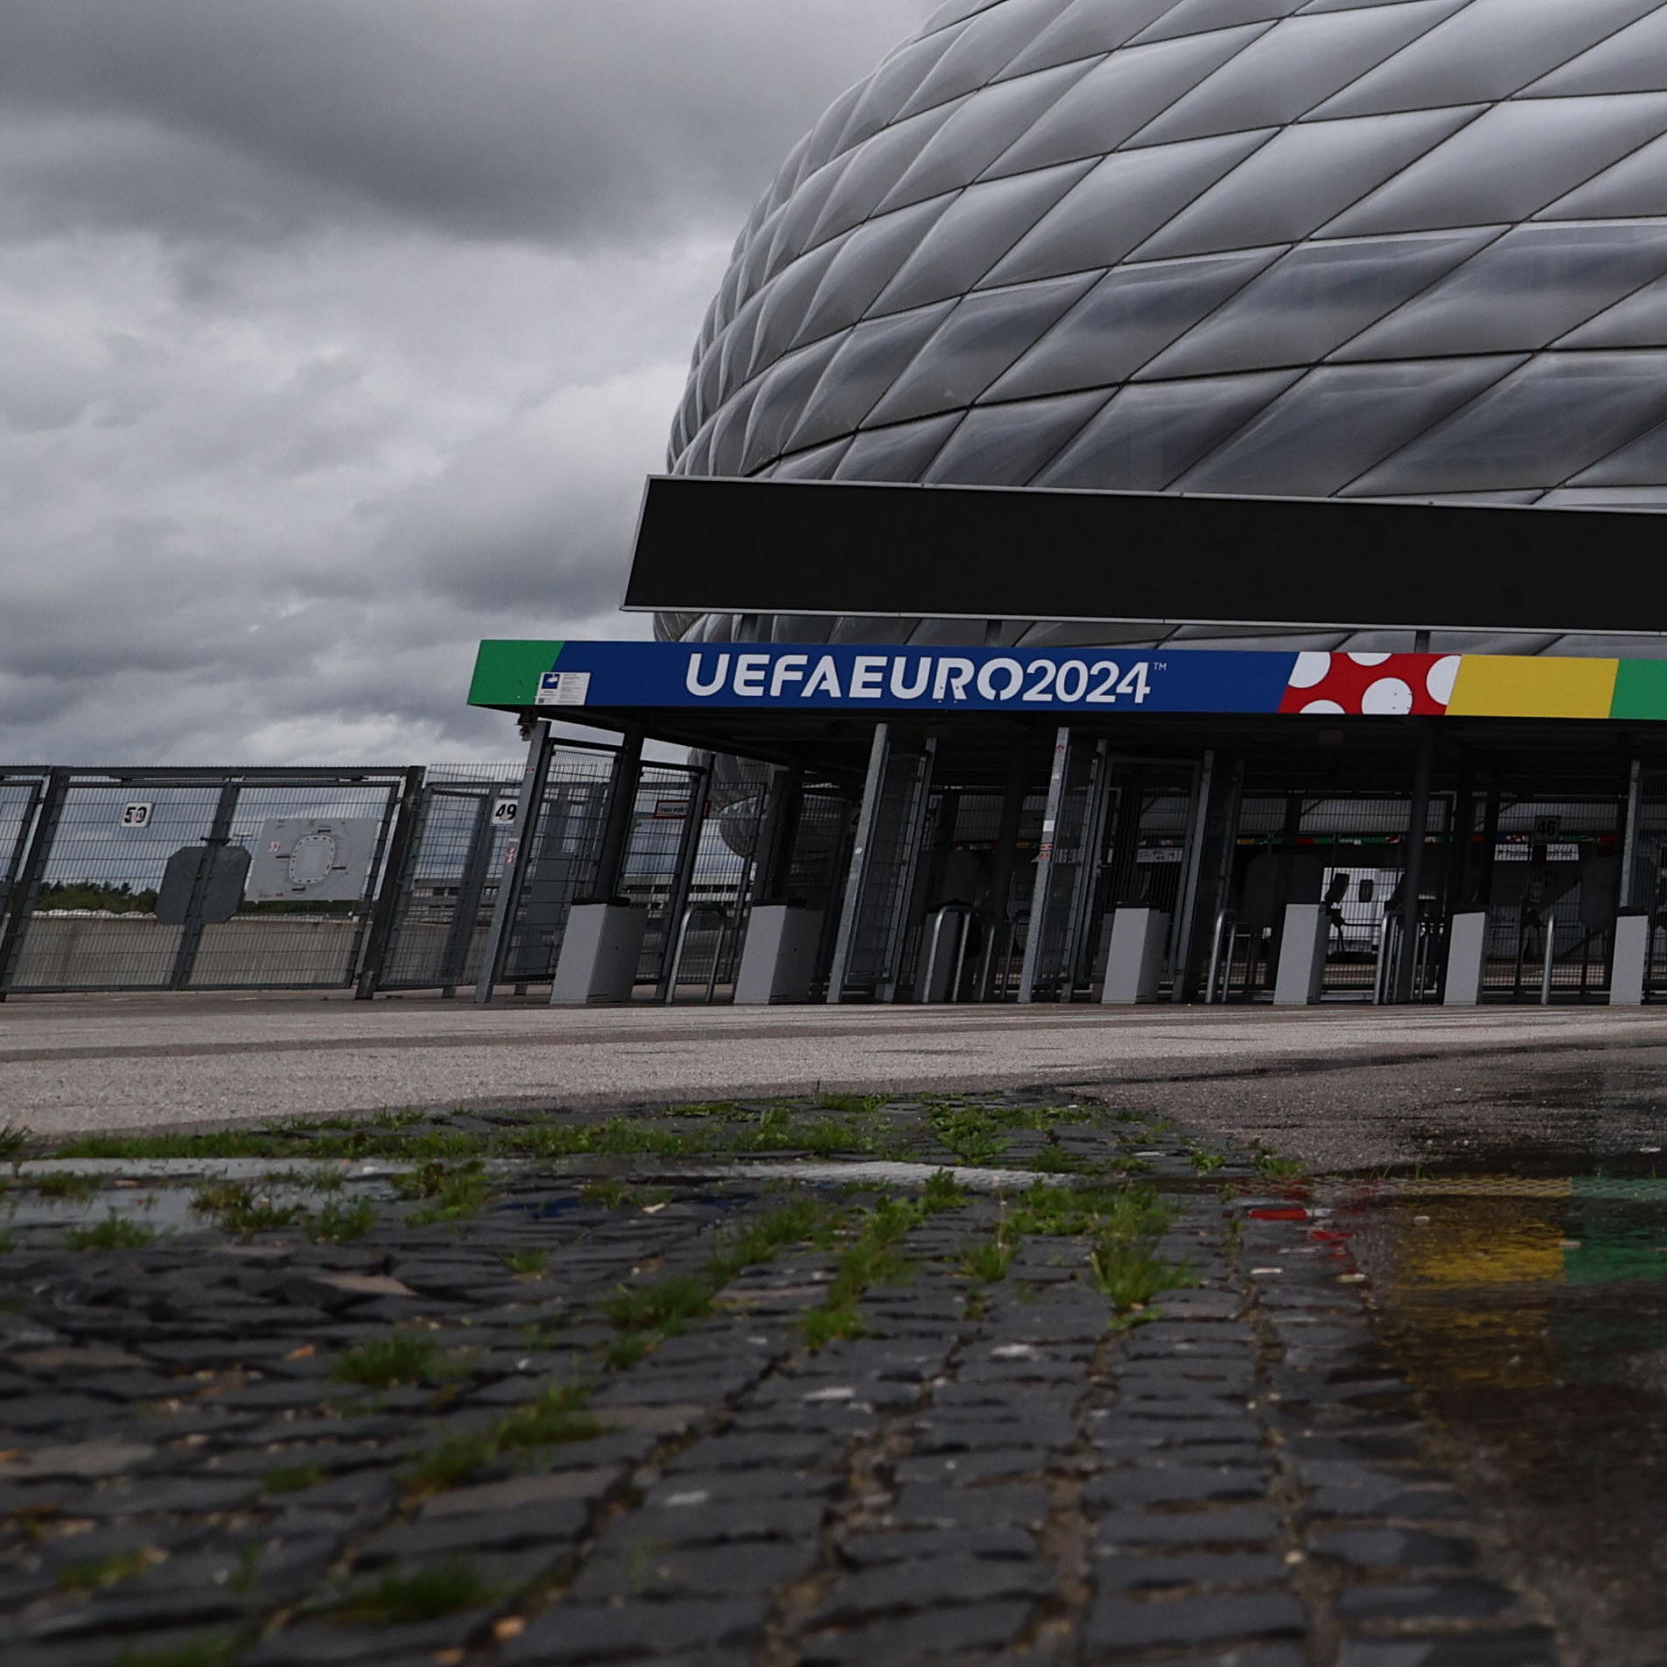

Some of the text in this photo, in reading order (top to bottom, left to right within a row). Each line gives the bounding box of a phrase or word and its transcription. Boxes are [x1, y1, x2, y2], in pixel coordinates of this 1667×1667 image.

[124, 806, 147, 823] 50
[495, 804, 517, 820] 49
[1536, 819, 1556, 836] 46
